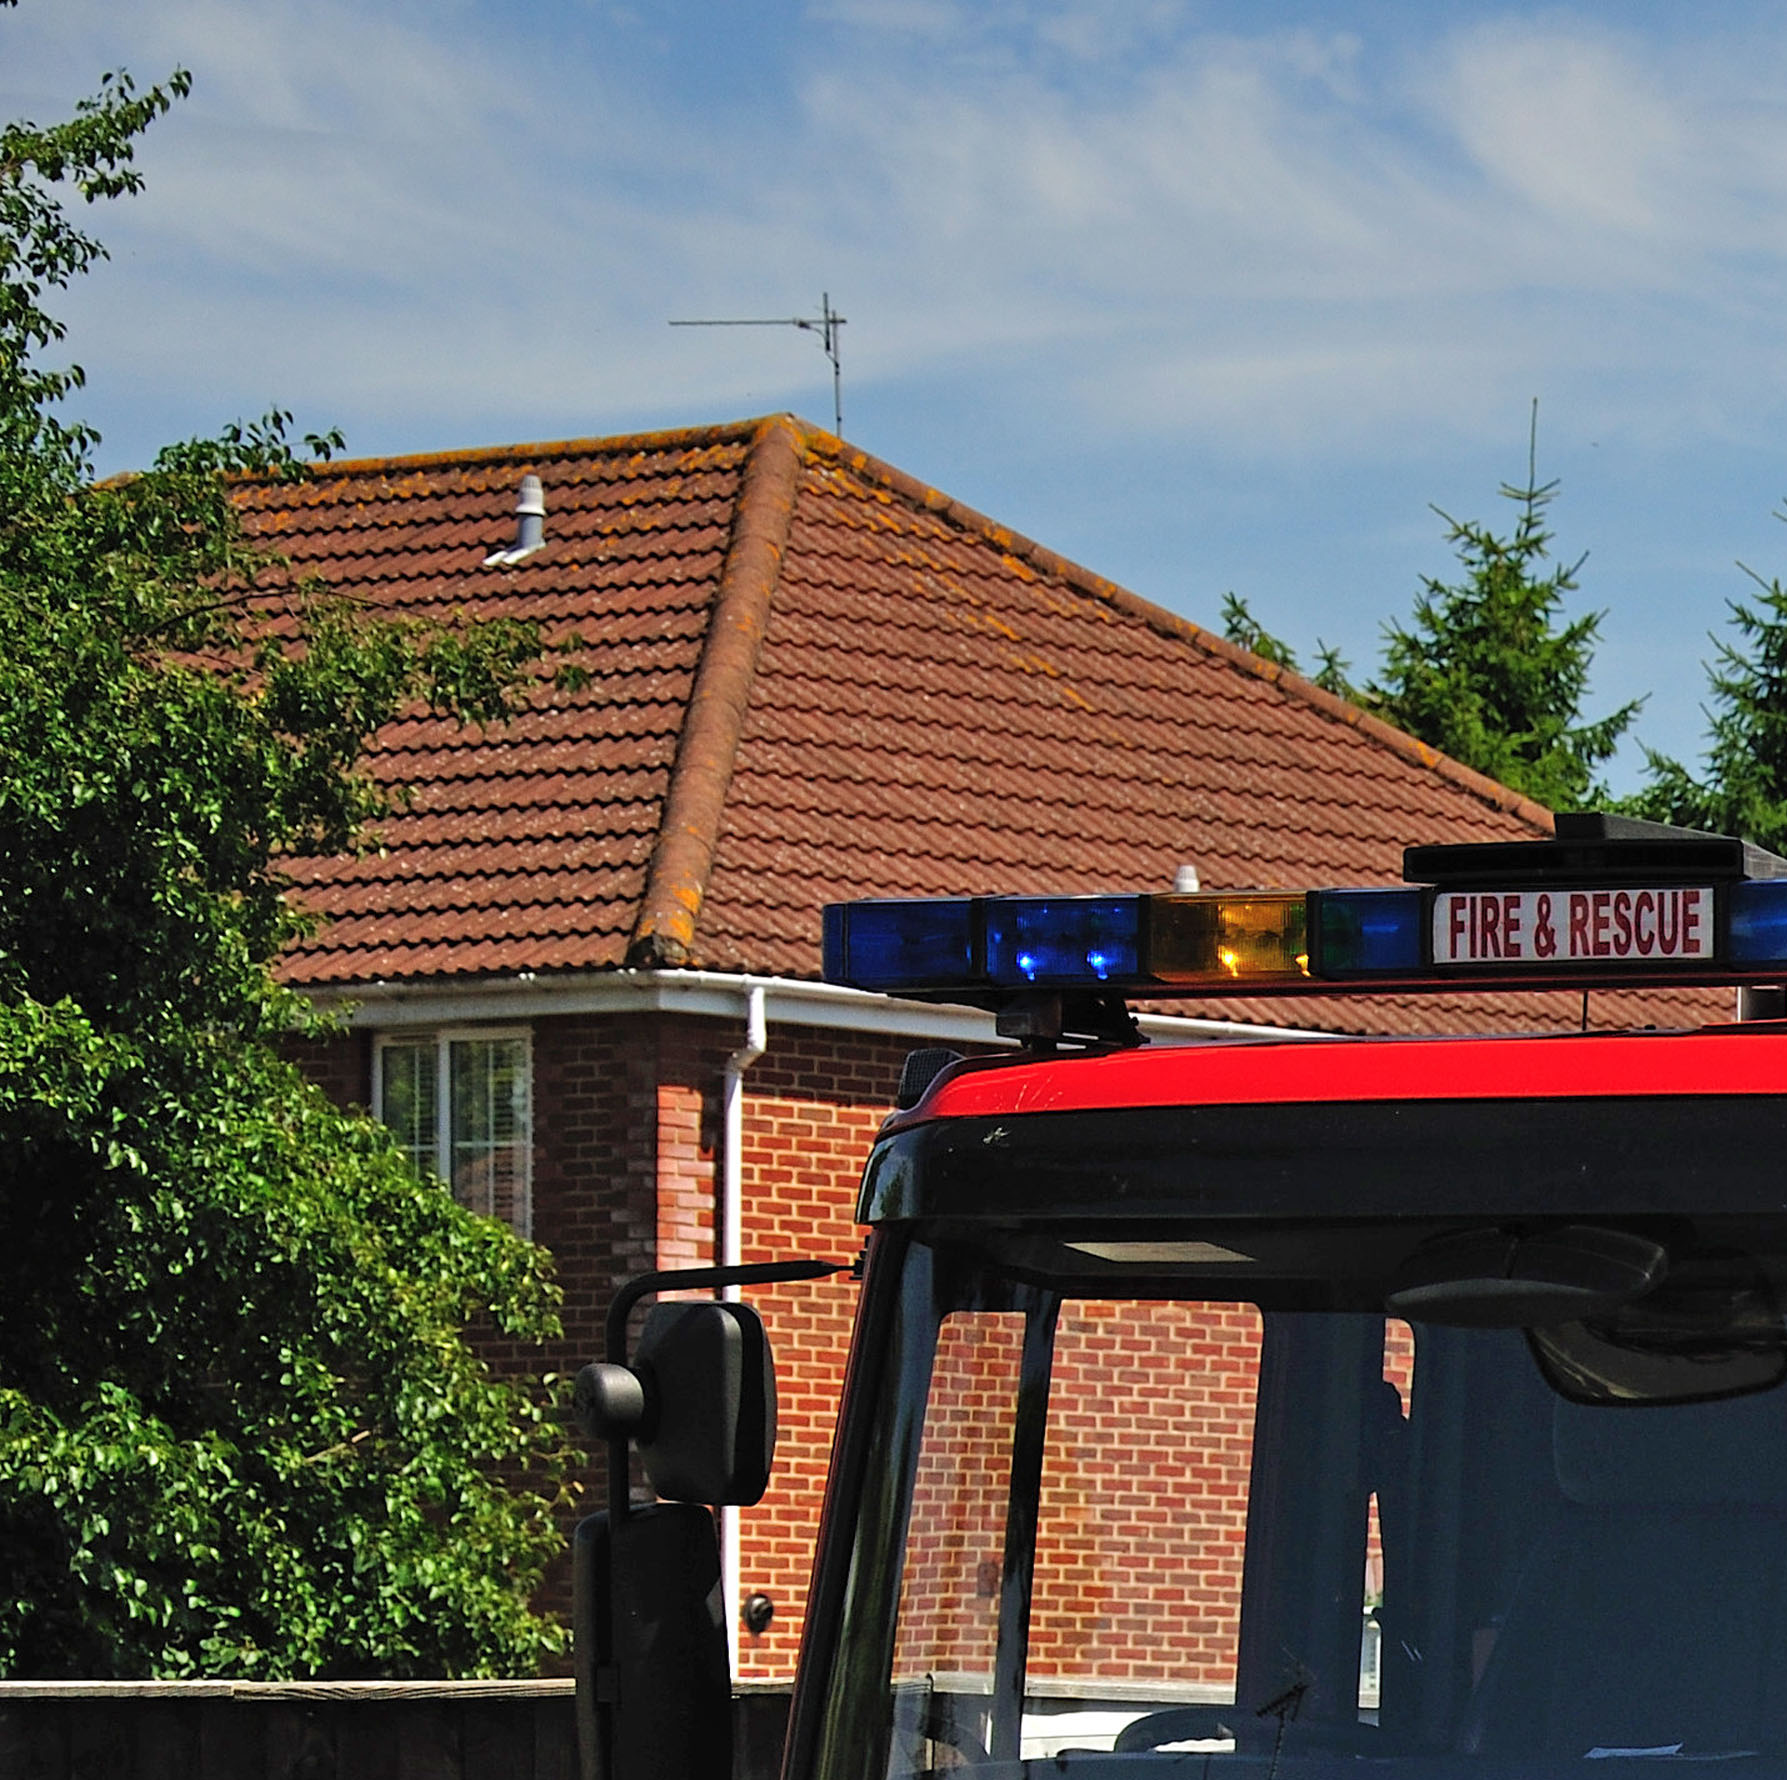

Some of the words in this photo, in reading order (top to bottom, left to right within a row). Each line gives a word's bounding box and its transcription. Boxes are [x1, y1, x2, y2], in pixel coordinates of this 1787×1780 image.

[1450, 895, 1521, 959] FIRE
[1534, 893, 1556, 958] &
[1569, 889, 1700, 957] RESCUE
